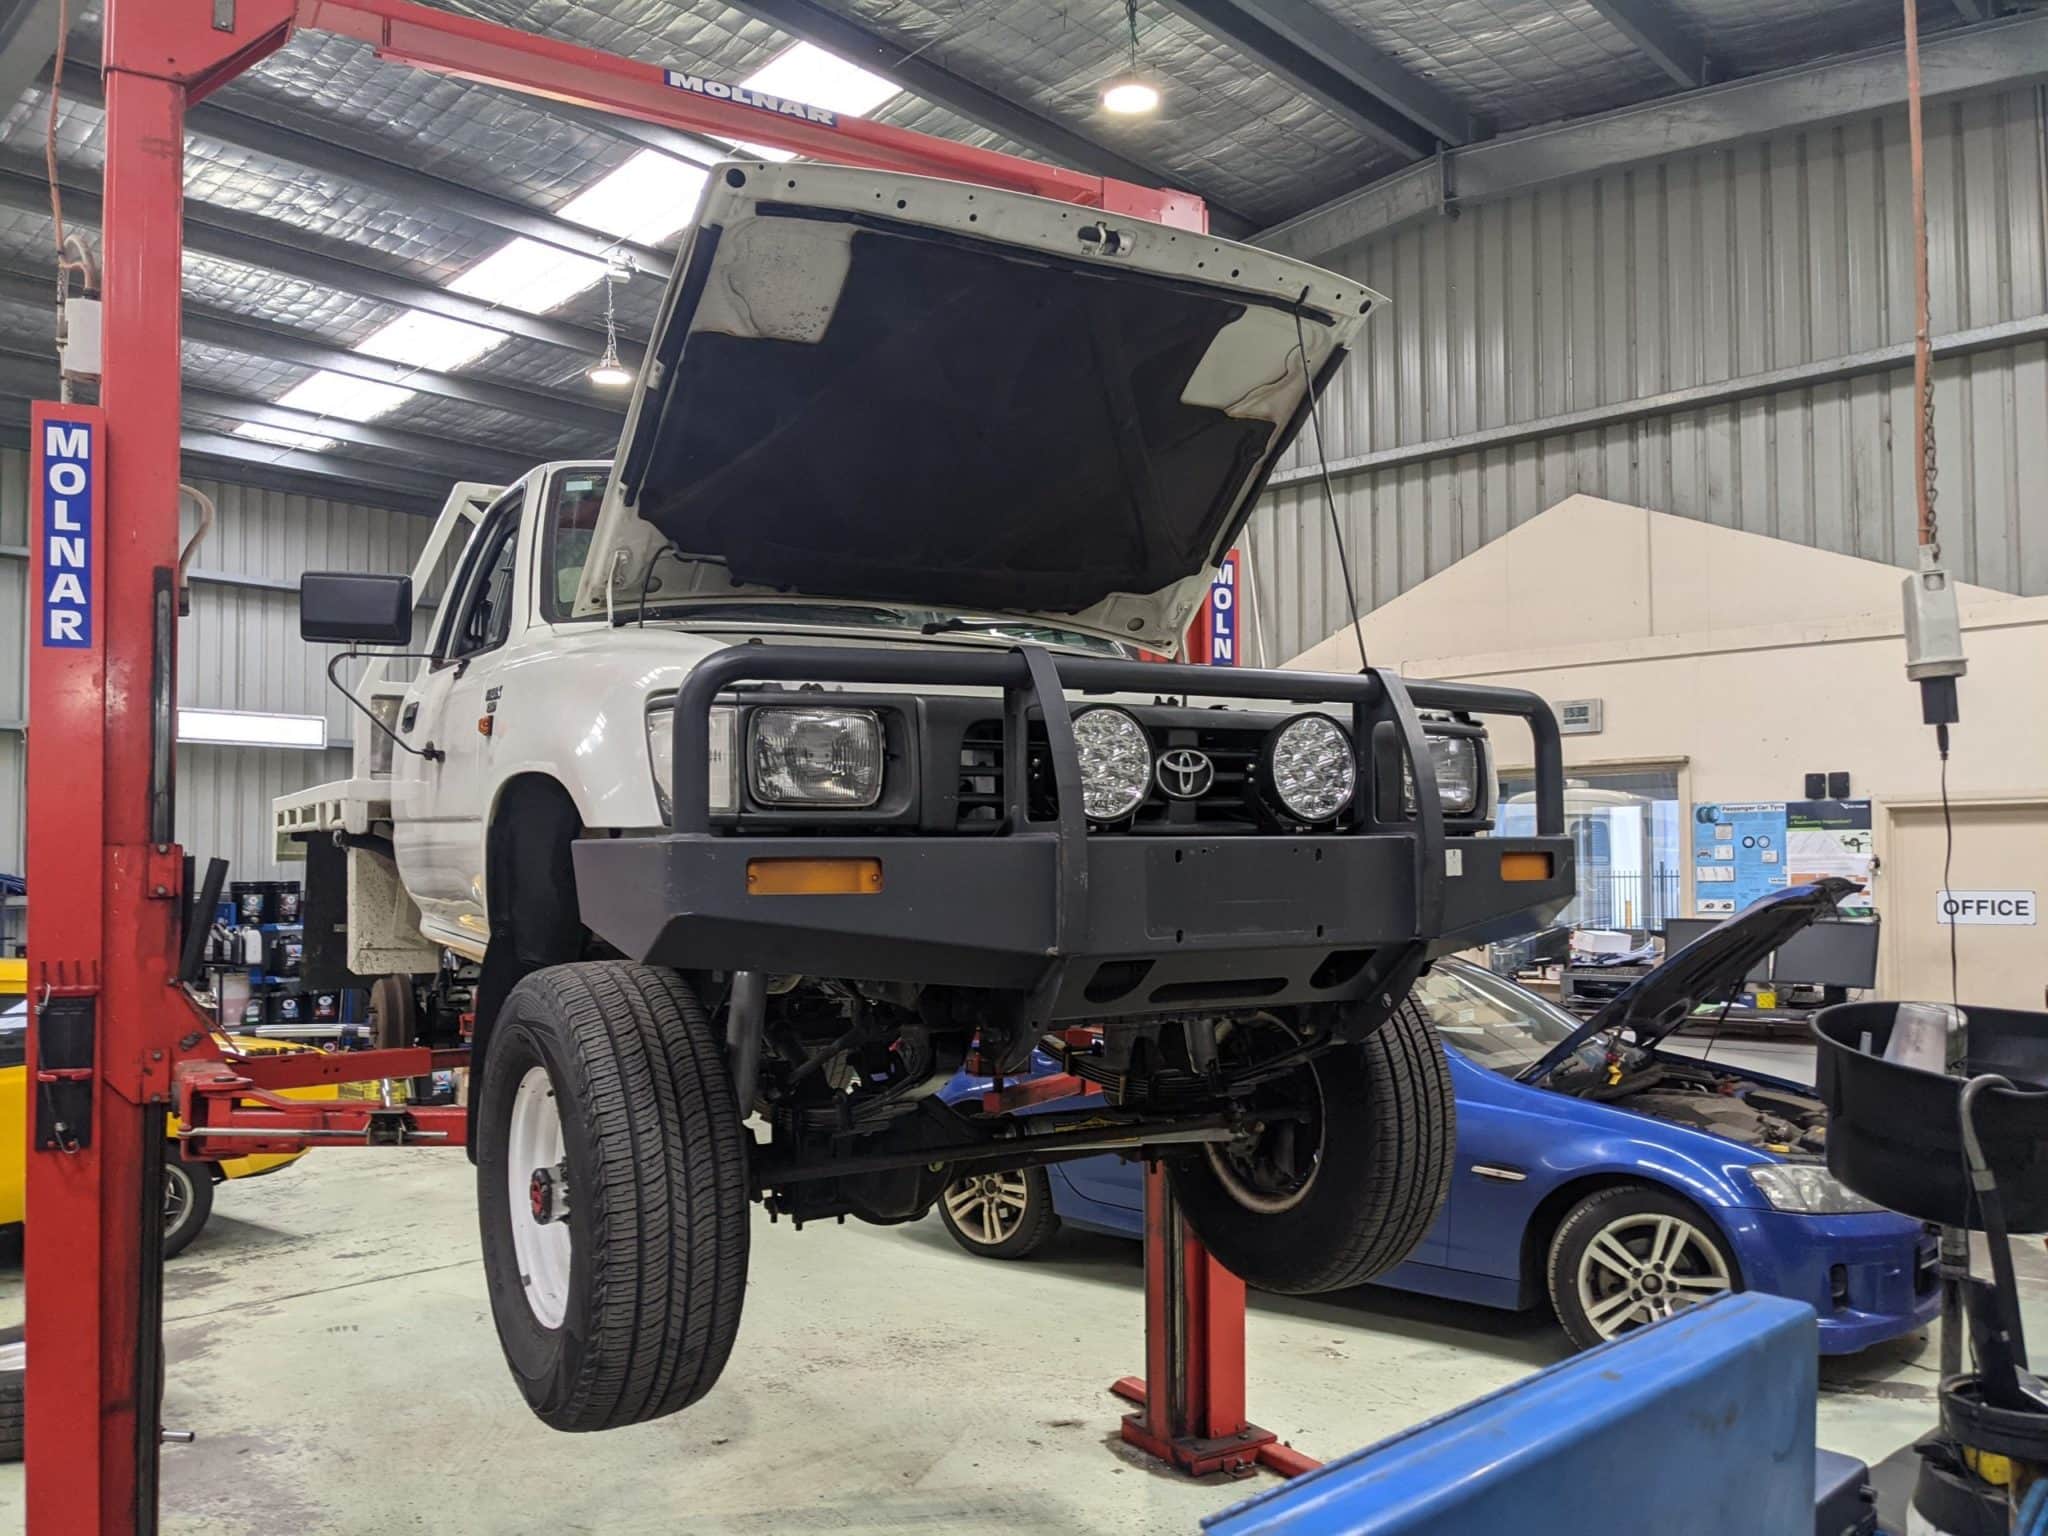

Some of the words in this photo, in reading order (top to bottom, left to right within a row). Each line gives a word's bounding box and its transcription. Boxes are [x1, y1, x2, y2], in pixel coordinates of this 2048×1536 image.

[669, 71, 833, 125] MOLNAR
[46, 426, 88, 641] MOLNAR
[1213, 564, 1233, 660] MOLN
[1943, 899, 2030, 916] OFFICE
